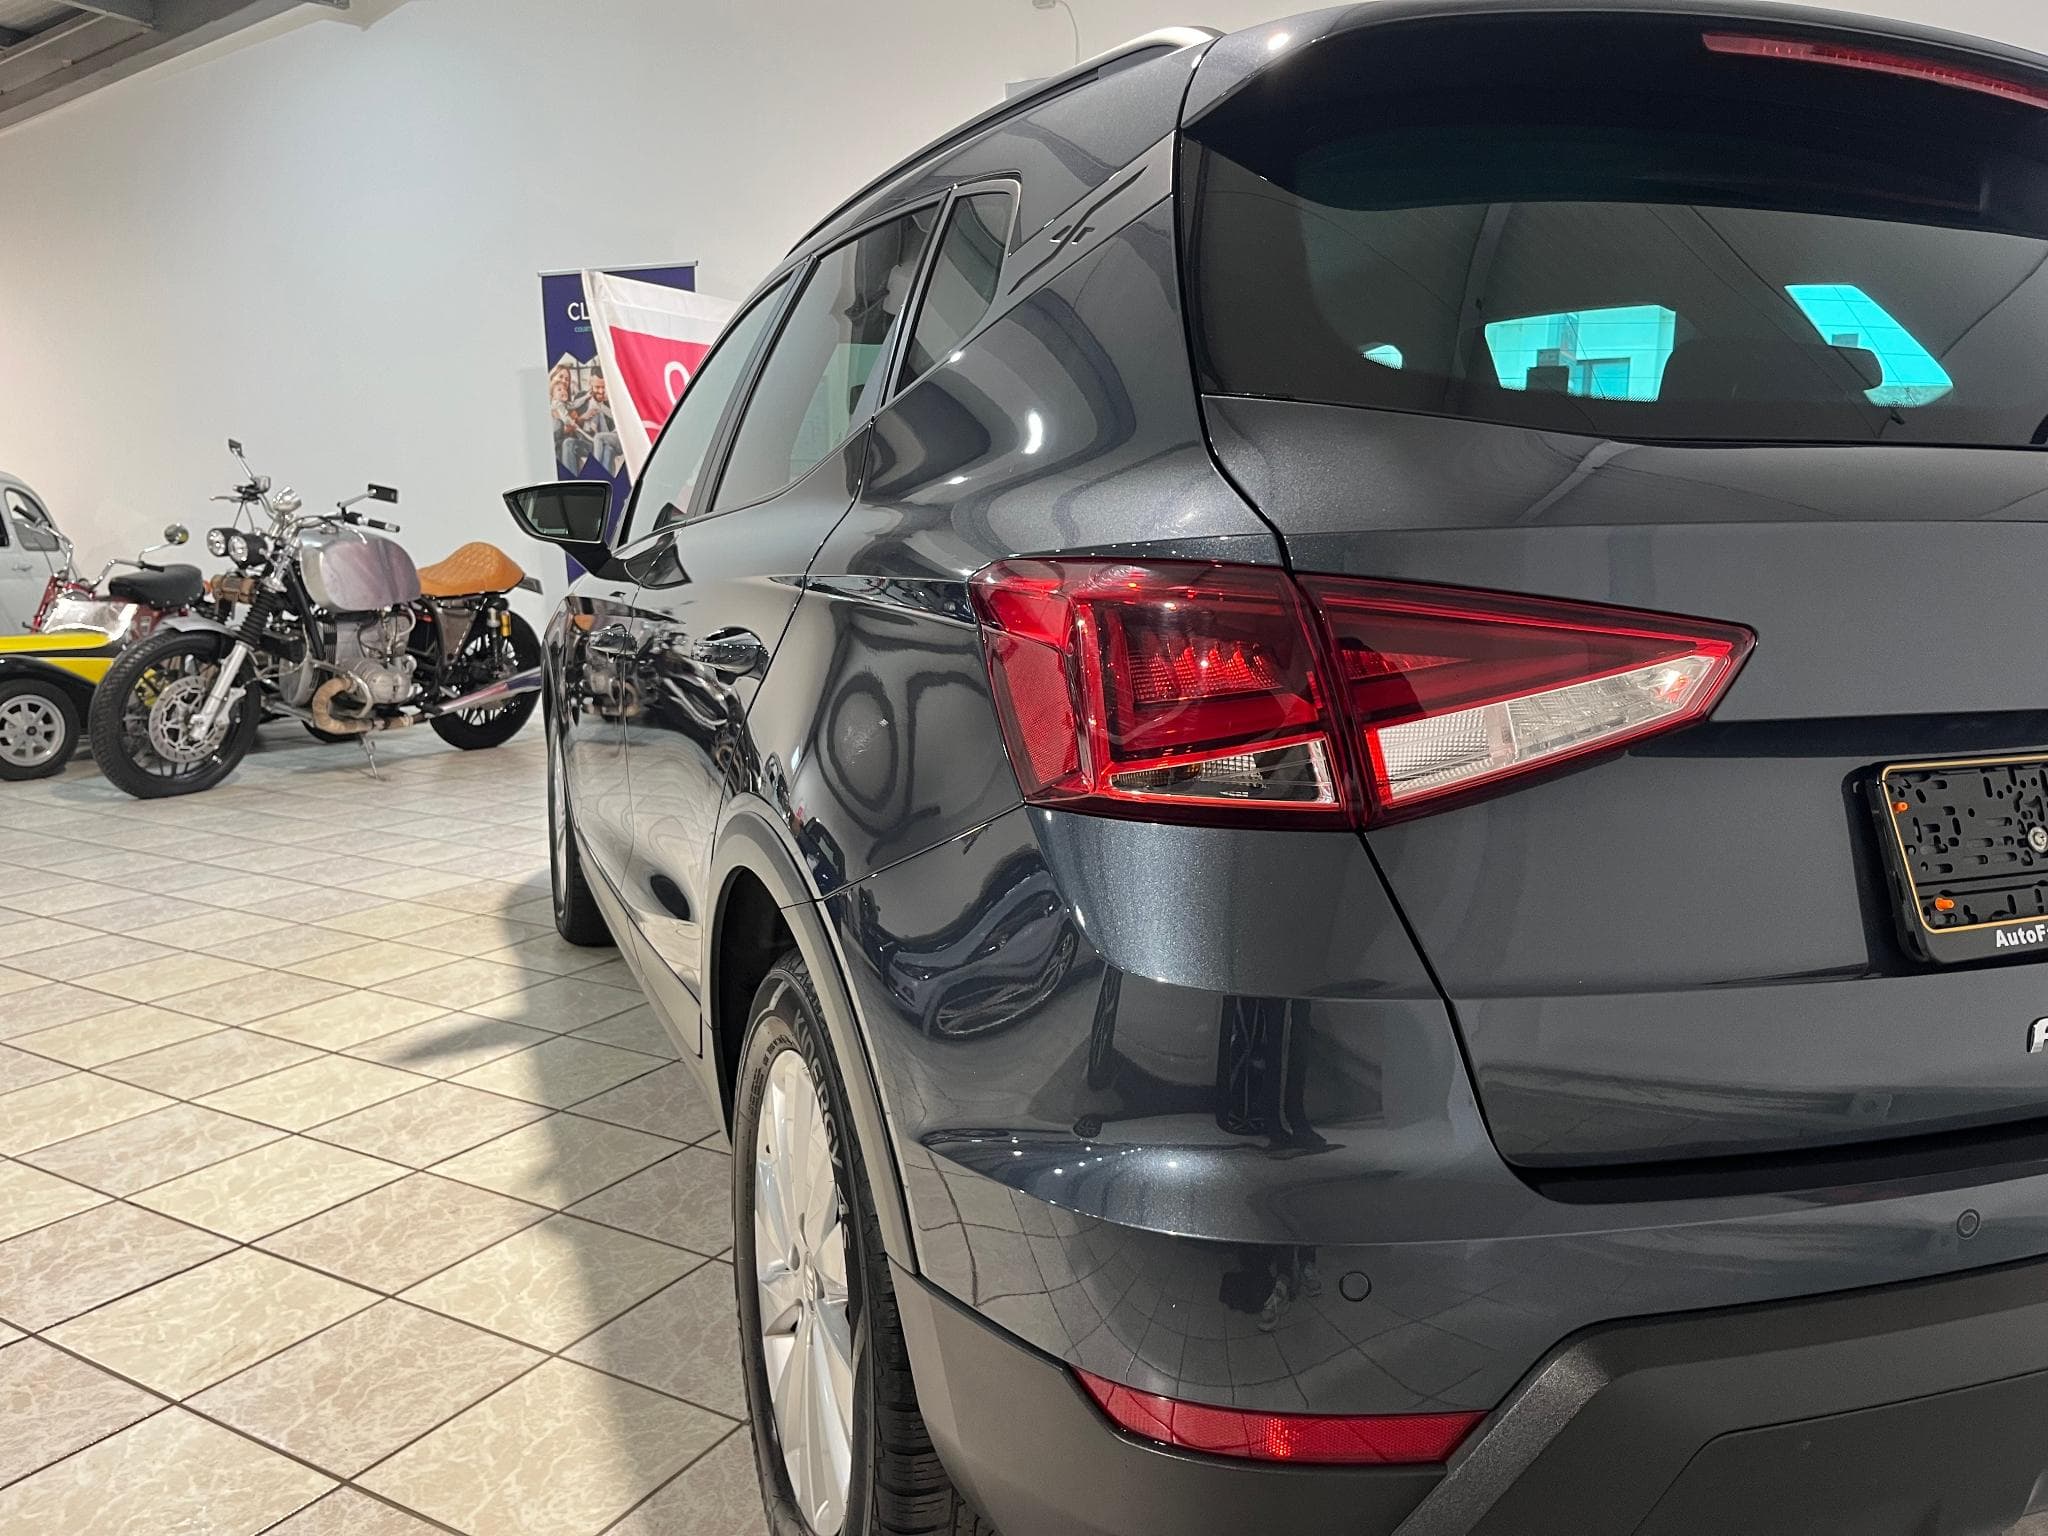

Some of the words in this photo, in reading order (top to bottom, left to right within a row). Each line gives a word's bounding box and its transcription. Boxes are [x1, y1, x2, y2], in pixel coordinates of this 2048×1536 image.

[567, 302, 590, 320] CL
[1996, 924, 2048, 948] AutoF
[794, 1008, 843, 1169] KINERGY
